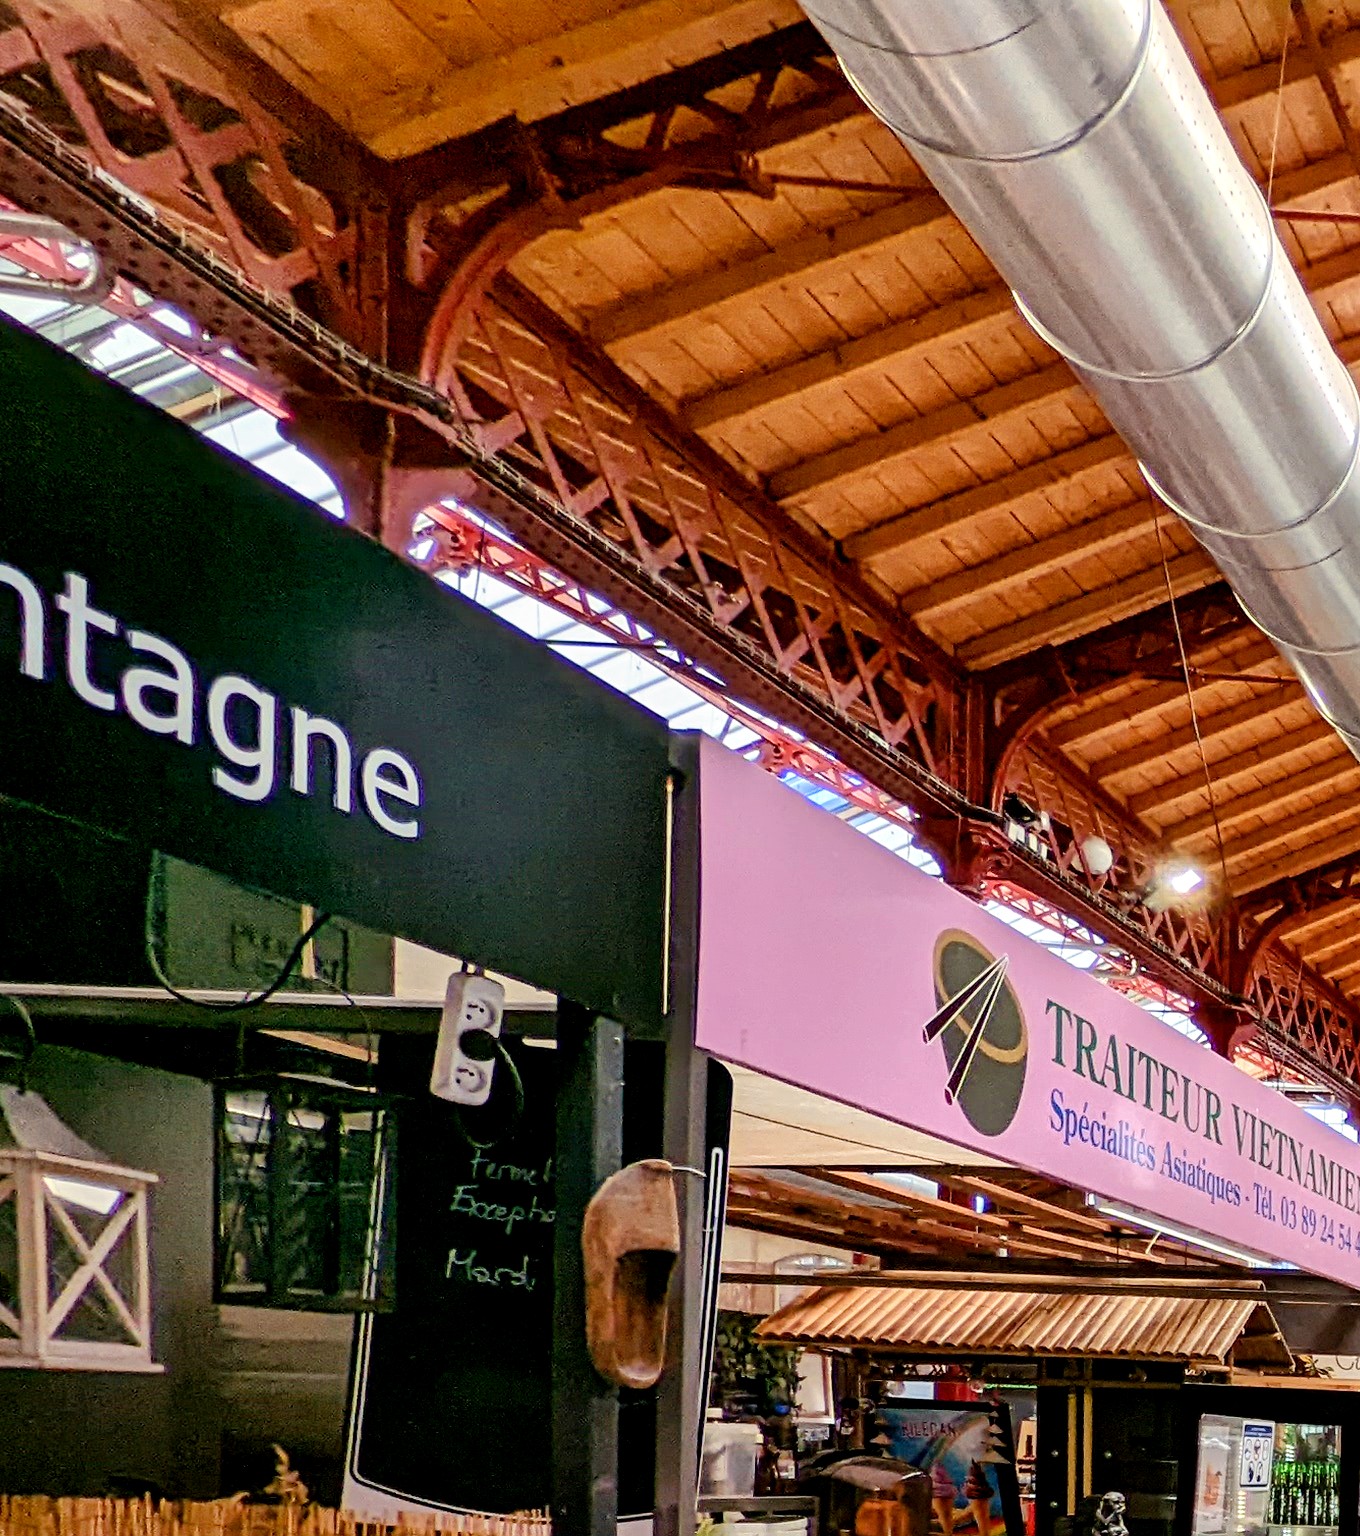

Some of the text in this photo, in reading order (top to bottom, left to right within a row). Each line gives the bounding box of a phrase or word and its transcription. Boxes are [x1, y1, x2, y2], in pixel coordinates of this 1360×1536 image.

[1045, 998, 1224, 1146] TRAITEUR
[1049, 1088, 1156, 1172] Spécialités
[1159, 1141, 1242, 1207] Asiatiques
[1253, 1182, 1276, 1223] Tél.
[1280, 1200, 1297, 1230] 03
[1301, 1207, 1317, 1237] 89
[1320, 1215, 1335, 1246] 24
[1338, 1224, 1352, 1254] 54
